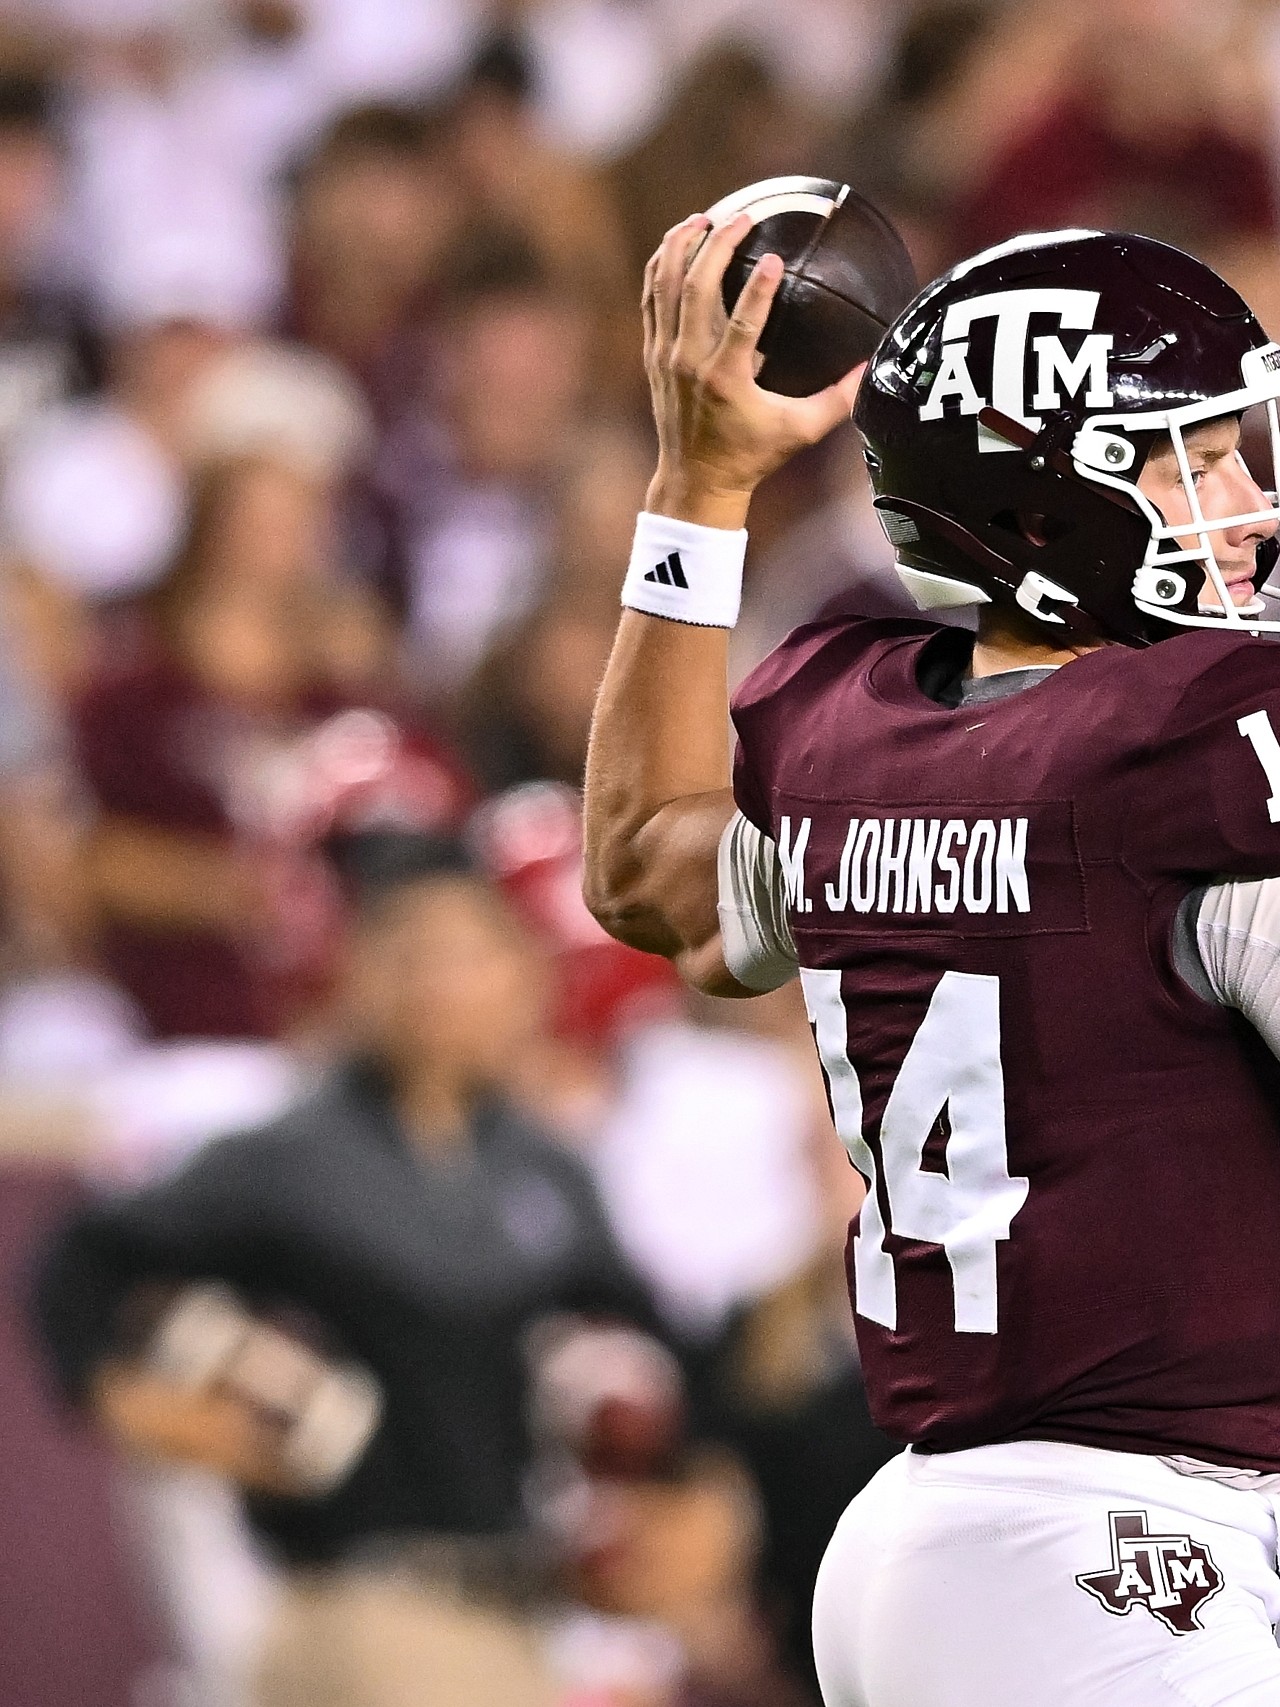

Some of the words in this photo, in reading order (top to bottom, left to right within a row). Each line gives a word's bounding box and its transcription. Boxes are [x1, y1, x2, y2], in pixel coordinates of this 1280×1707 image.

[779, 815, 812, 913] M.
[825, 817, 1031, 913] JOHNSON
[800, 968, 1029, 1333] 14
